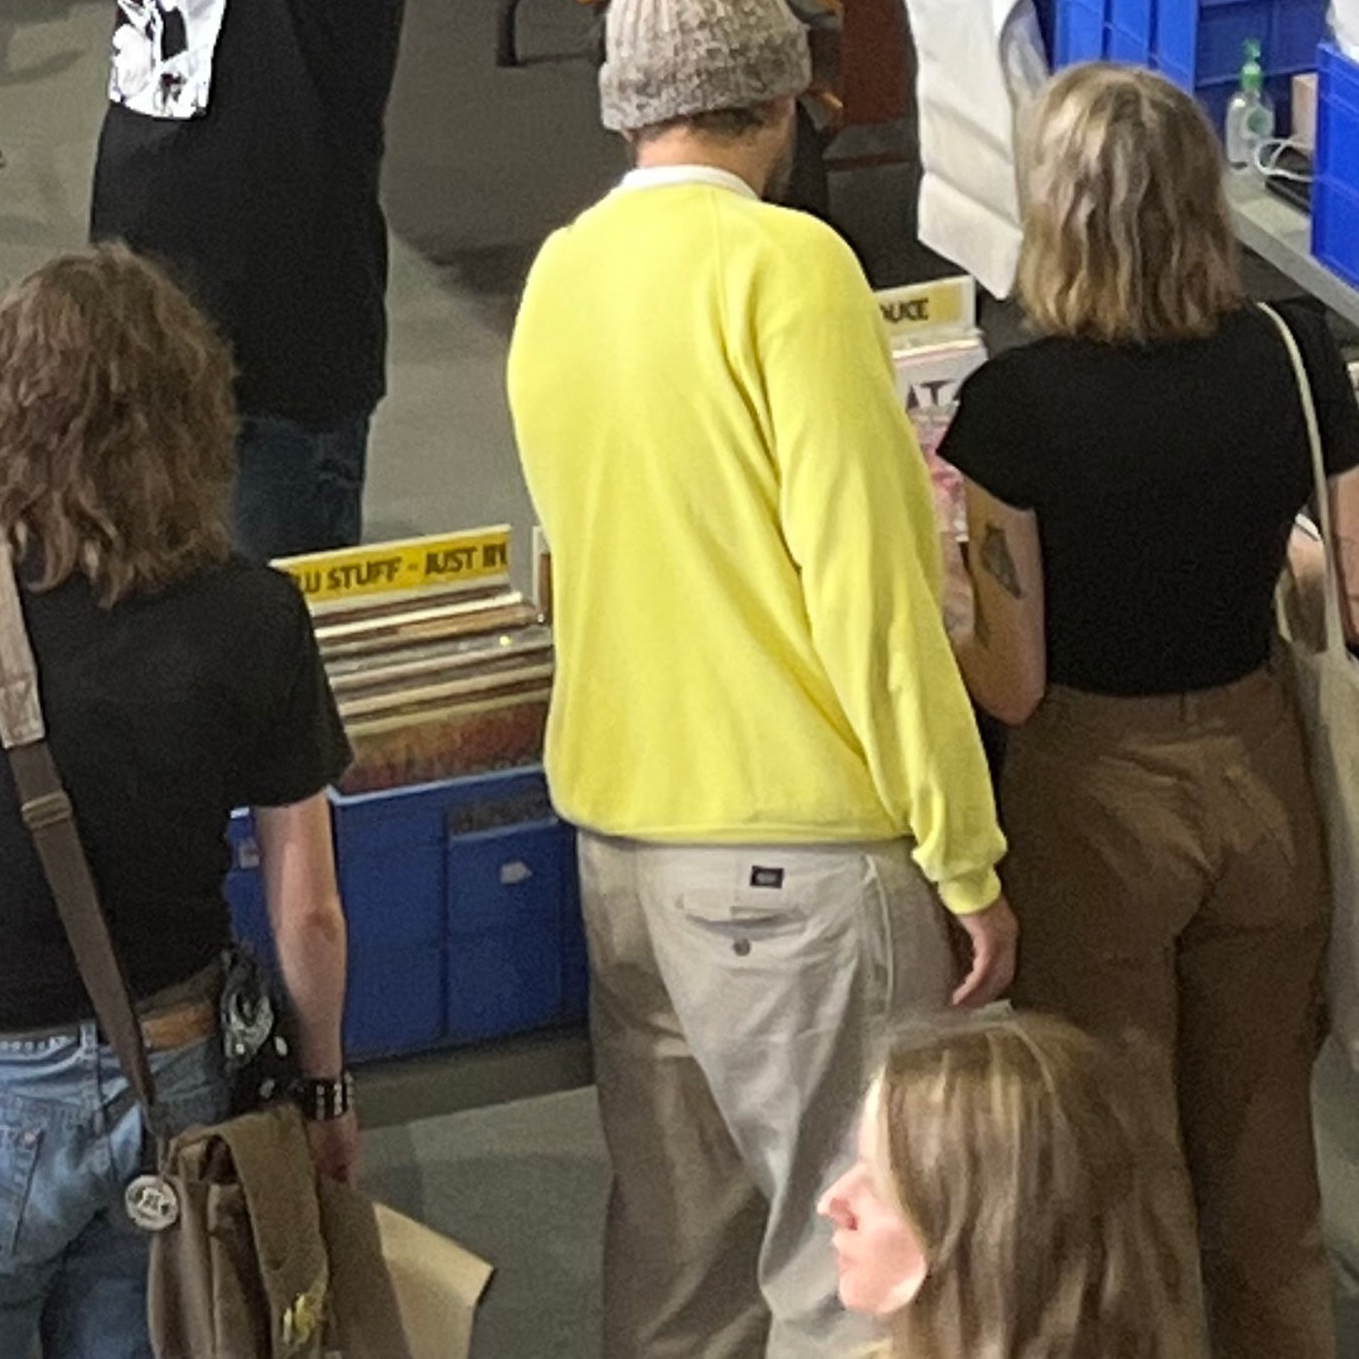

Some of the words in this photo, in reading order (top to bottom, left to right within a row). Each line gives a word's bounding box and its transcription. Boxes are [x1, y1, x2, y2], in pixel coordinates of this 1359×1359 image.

[326, 557, 403, 590] STUFF
[424, 544, 477, 576] JUST
[482, 541, 508, 568] IN
